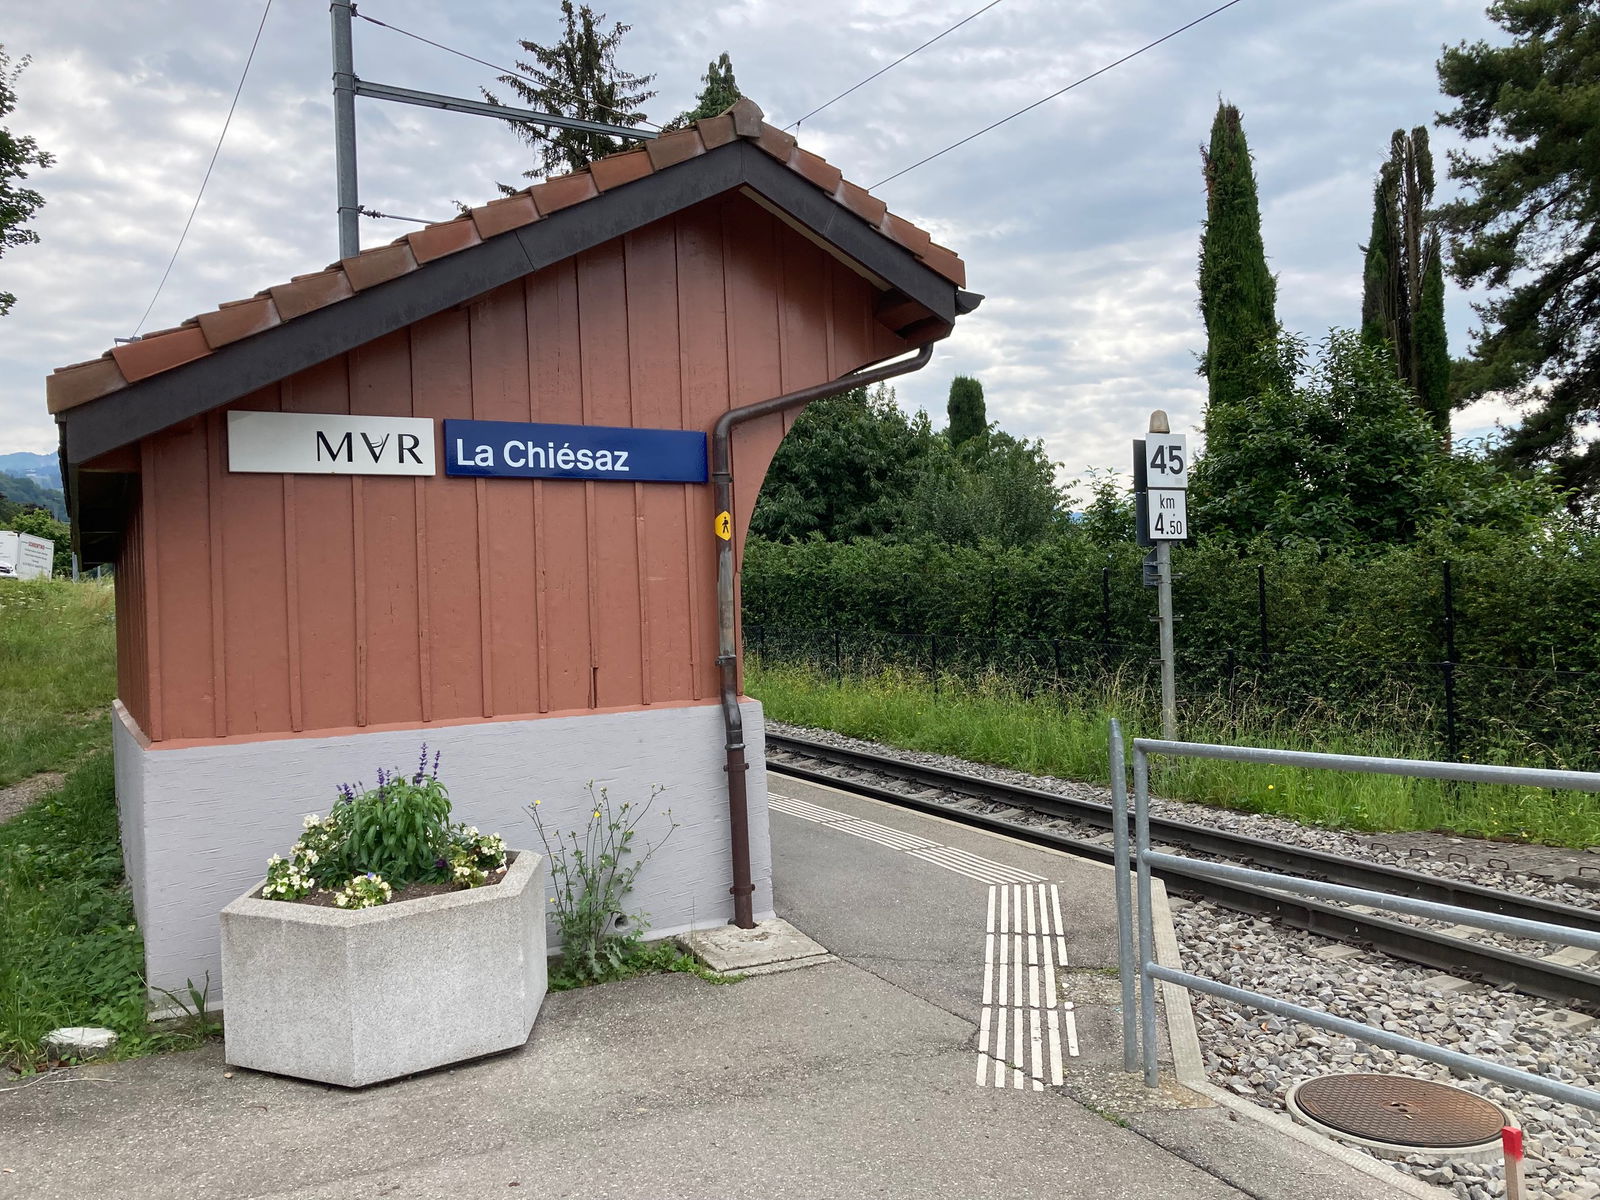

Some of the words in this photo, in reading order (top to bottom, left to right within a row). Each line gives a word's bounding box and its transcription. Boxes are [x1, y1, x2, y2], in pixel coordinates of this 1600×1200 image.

[456, 438, 494, 467] La
[503, 440, 630, 472] Chiésaz
[1150, 445, 1184, 475] 45
[1159, 493, 1175, 509] km
[1154, 512, 1183, 535] 4.50
